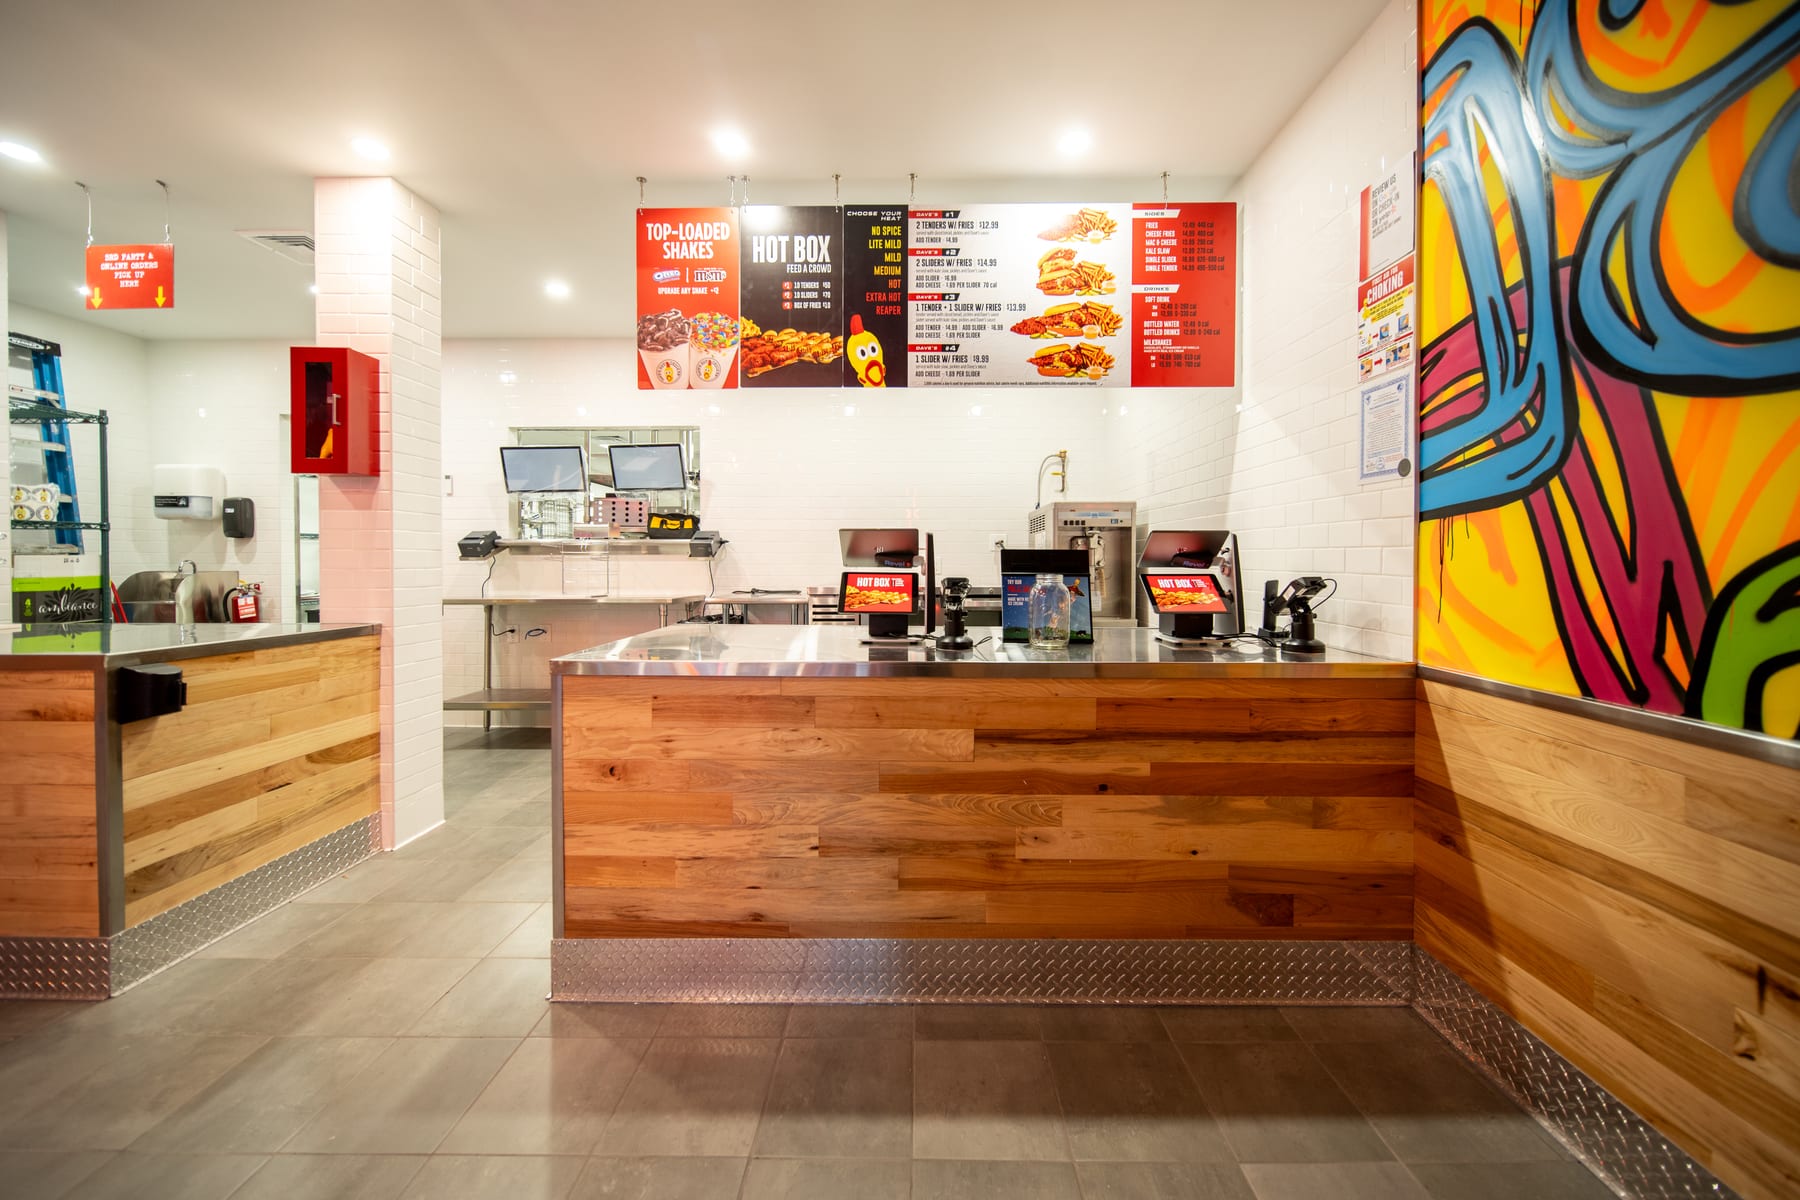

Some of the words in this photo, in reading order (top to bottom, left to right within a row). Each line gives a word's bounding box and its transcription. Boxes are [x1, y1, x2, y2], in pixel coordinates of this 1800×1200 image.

[1372, 179, 1389, 198] REVIEW
[1390, 173, 1397, 186] US
[916, 221, 921, 229] 2
[922, 221, 947, 229] TENDERS
[948, 221, 957, 229] W/
[958, 221, 975, 229] FRIES
[979, 221, 999, 229] $12.99
[646, 222, 731, 241] TOP-LOADED
[872, 226, 881, 236] NO
[882, 226, 902, 236] SPICE
[753, 235, 790, 263] HOT
[794, 235, 831, 263] BOX
[869, 240, 883, 249] LITE
[885, 240, 902, 249] MILD
[662, 241, 714, 259] SHAKES
[122, 253, 145, 261] PARTY
[885, 253, 902, 263] MILD
[916, 259, 921, 267] 2
[922, 259, 945, 267] SLIDERS
[946, 259, 955, 267] W/
[957, 259, 973, 267] FRIES
[978, 259, 997, 267] $14.99
[787, 264, 802, 273] FEED
[803, 264, 808, 273] A
[809, 264, 832, 273] CROWD
[874, 266, 902, 276] MEDIUM
[135, 271, 145, 279] UP
[120, 280, 139, 288] HERE
[888, 279, 902, 289] HOT
[1367, 271, 1404, 305] CHOKING
[681, 287, 691, 295] ANY
[866, 292, 887, 302] EXTRA
[888, 292, 902, 302] HOT
[876, 306, 902, 315] REAPER
[916, 304, 919, 312] 1
[921, 304, 943, 312] TENDER
[949, 304, 953, 312] 1
[954, 304, 974, 312] SLIDER
[975, 304, 984, 312] W/
[986, 304, 1002, 312] FRIES
[1007, 304, 1027, 312] $13.99
[916, 355, 919, 363] 1
[921, 355, 941, 363] SLIDER
[942, 355, 950, 363] W/
[952, 355, 968, 363] FRIES
[857, 577, 873, 587] HOT
[874, 577, 890, 587] BOX
[1158, 579, 1175, 588] HOT
[1175, 579, 1192, 588] BOX
[39, 594, 98, 615] ambiance
